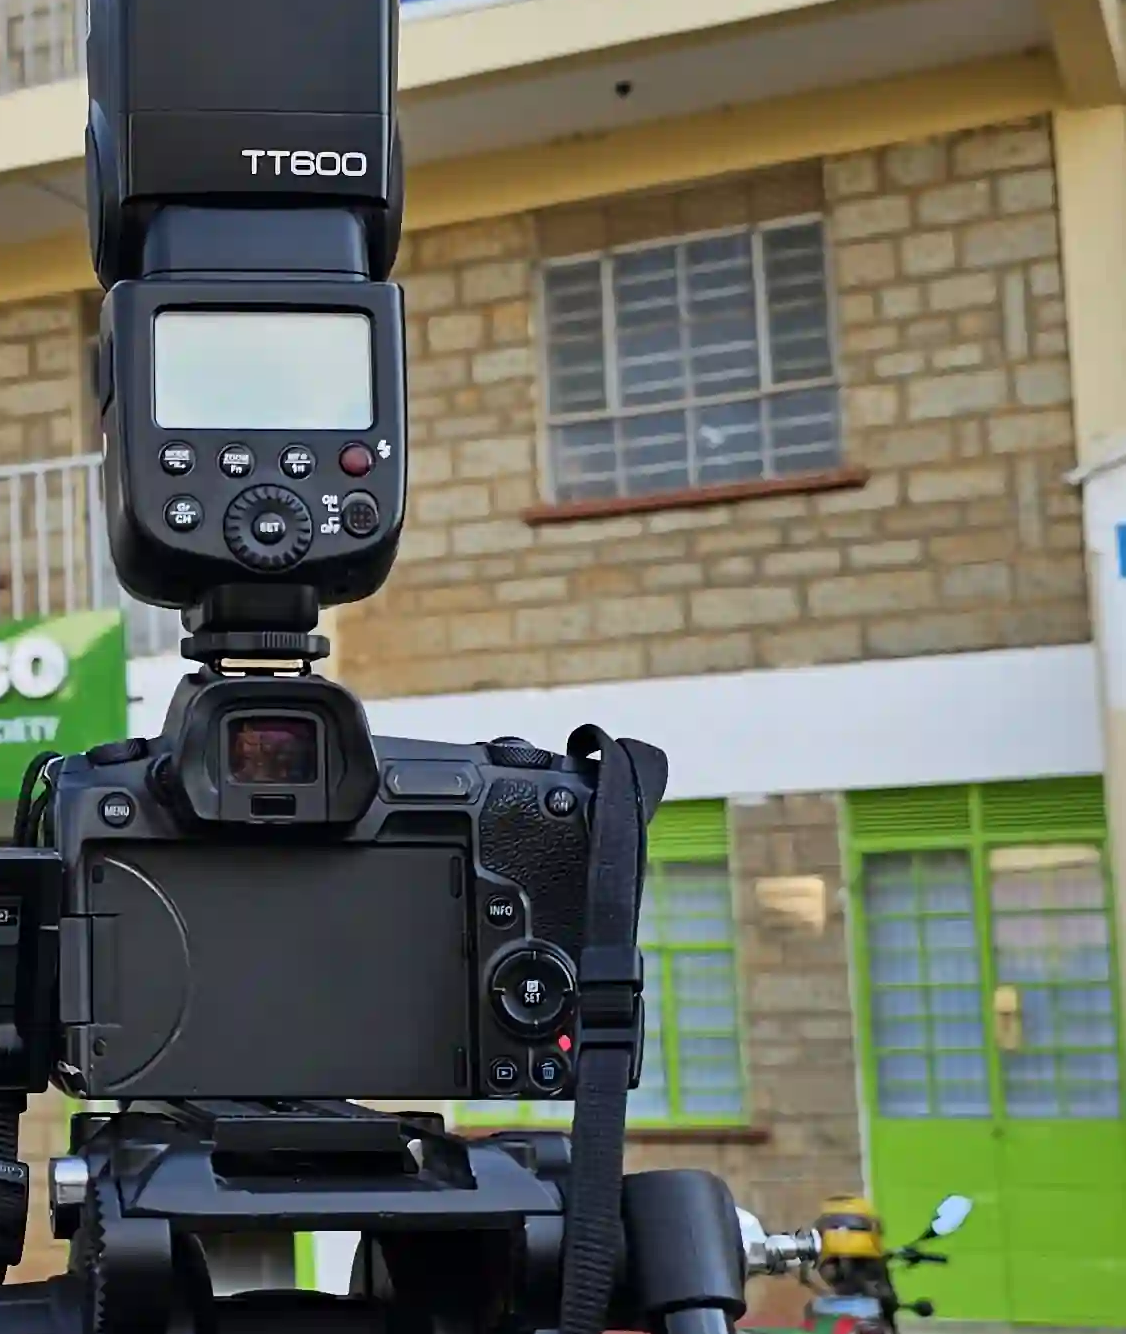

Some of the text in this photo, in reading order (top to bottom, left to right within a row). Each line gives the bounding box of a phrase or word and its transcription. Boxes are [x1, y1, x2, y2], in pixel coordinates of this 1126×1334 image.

[241, 149, 368, 177] TT600
[259, 522, 280, 533] SET
[104, 804, 130, 817] MENU
[554, 800, 569, 812] ON
[489, 905, 514, 917] INFO
[524, 992, 541, 1004] SET
